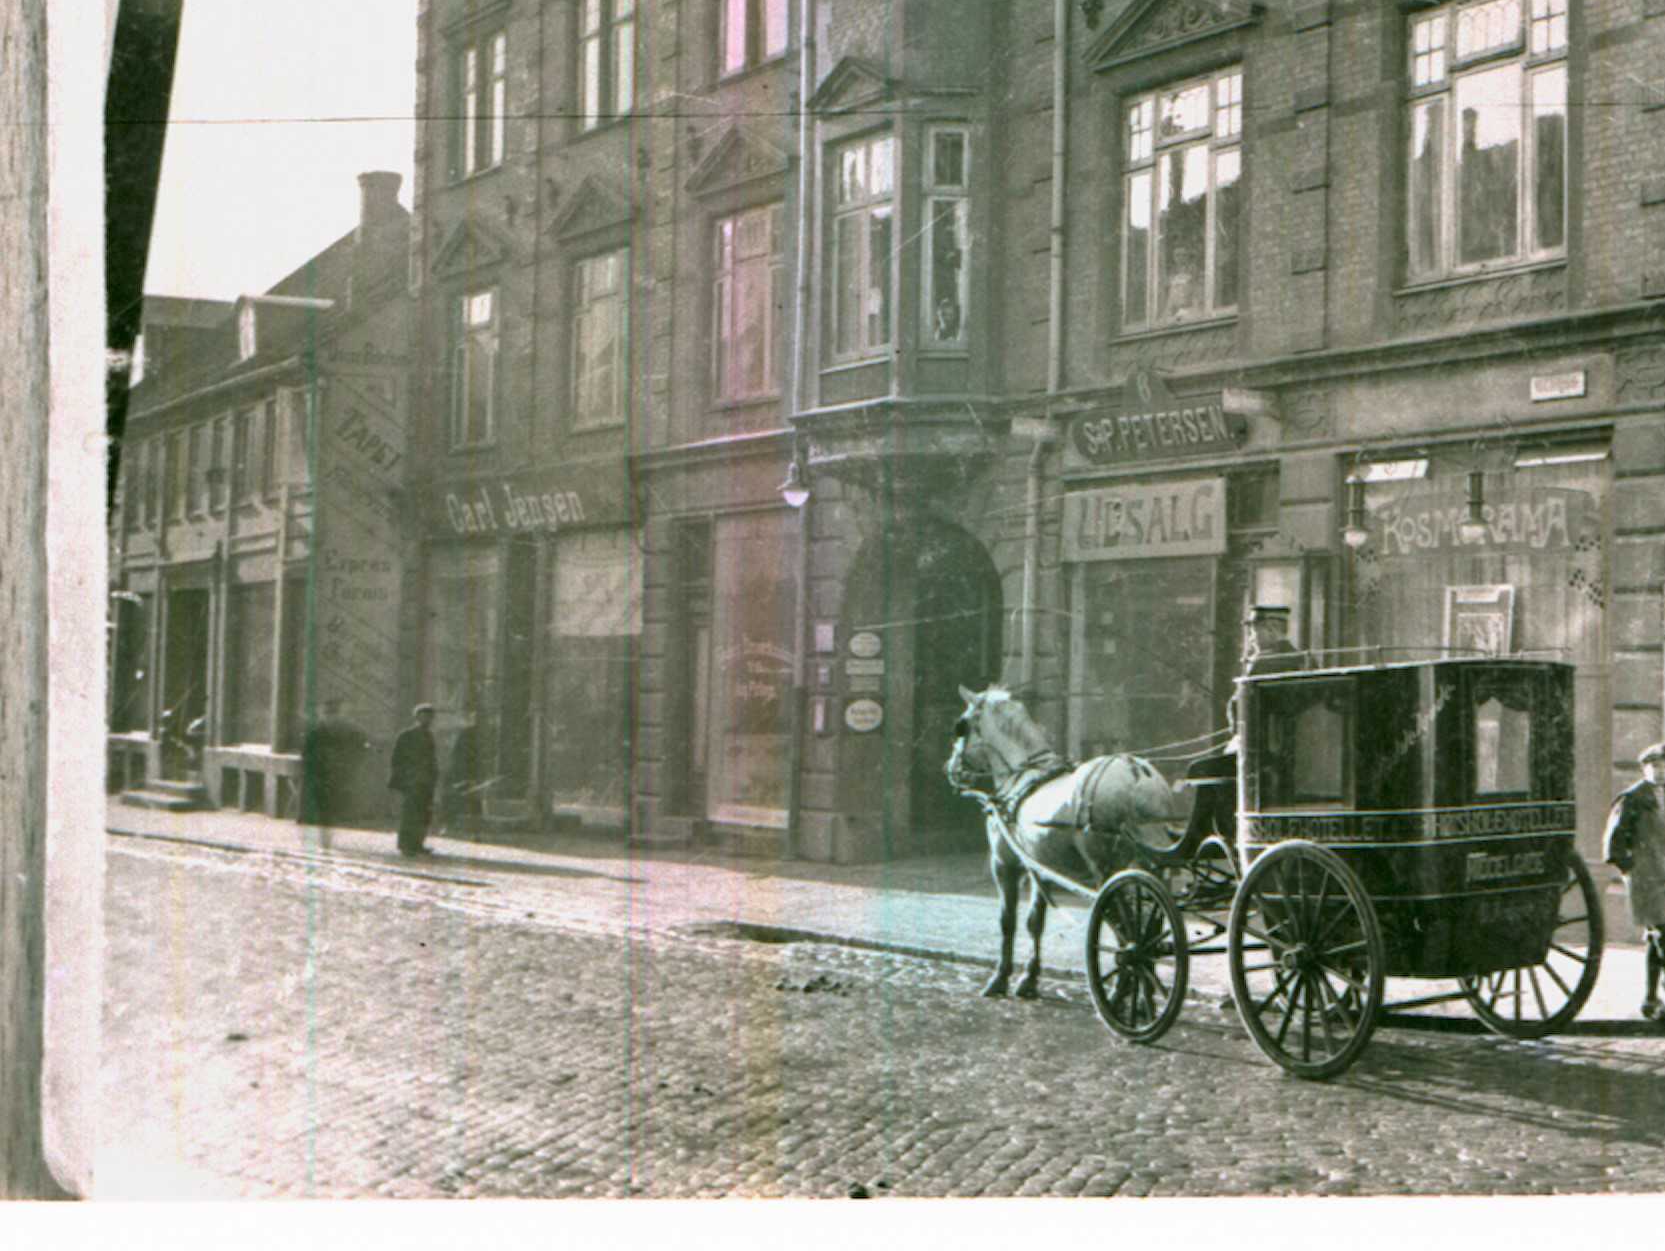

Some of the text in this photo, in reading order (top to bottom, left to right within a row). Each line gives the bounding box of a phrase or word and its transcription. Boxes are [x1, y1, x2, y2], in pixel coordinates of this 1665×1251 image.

[445, 486, 499, 534] Carl
[502, 481, 586, 533] Jensen
[1077, 484, 1214, 550] UDSALG
